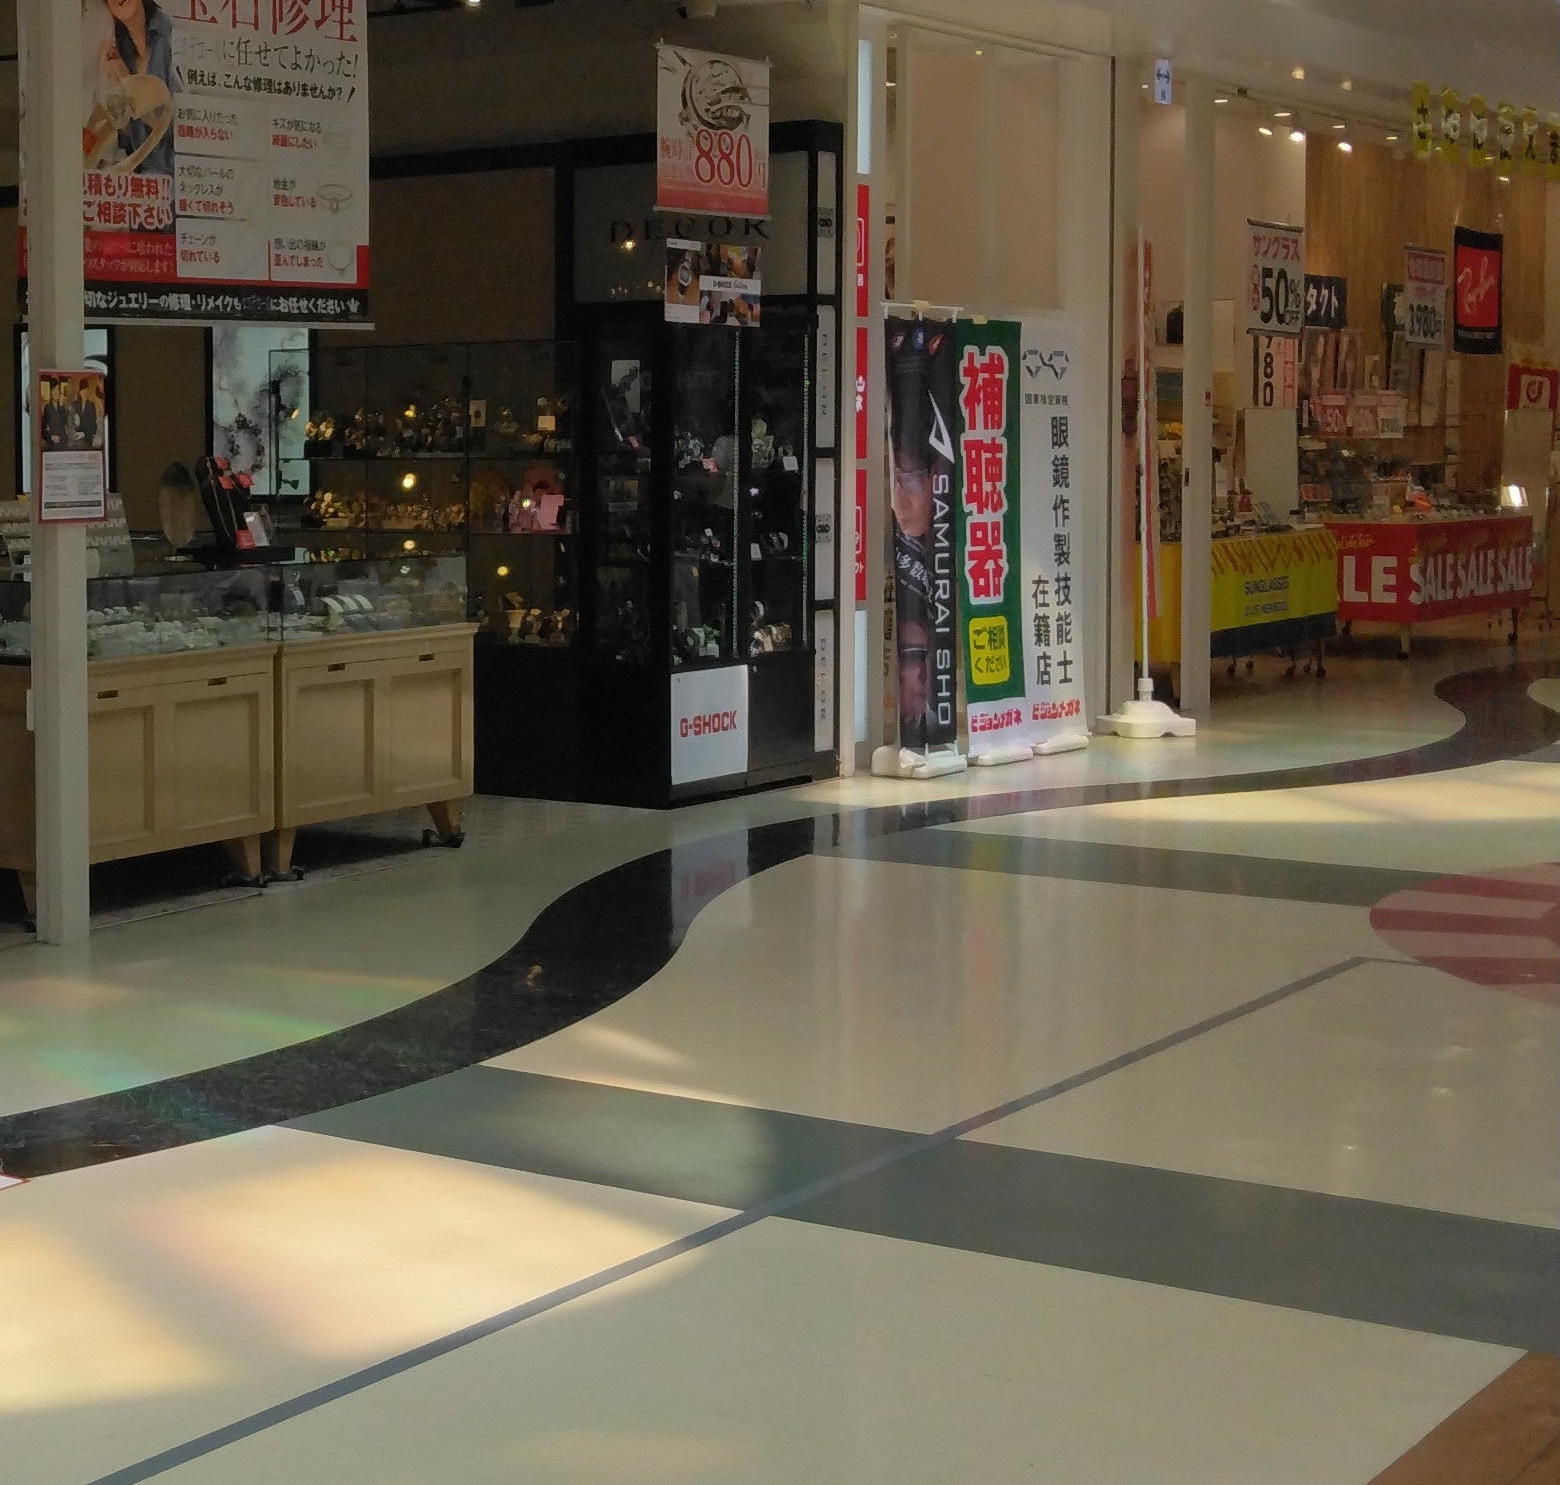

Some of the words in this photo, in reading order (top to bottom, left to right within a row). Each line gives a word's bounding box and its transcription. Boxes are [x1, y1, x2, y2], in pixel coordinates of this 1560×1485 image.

[961, 349, 1005, 599] 補聴器
[931, 472, 952, 635] SAMURAI
[1049, 415, 1075, 686] 眼鏡作製技能士
[1339, 555, 1399, 605] LE
[1408, 553, 1455, 605] SALE
[1456, 549, 1495, 599] SALE
[936, 647, 953, 727] SHO
[1031, 574, 1053, 687] 在籍店
[679, 709, 738, 738] G-SHOCK
